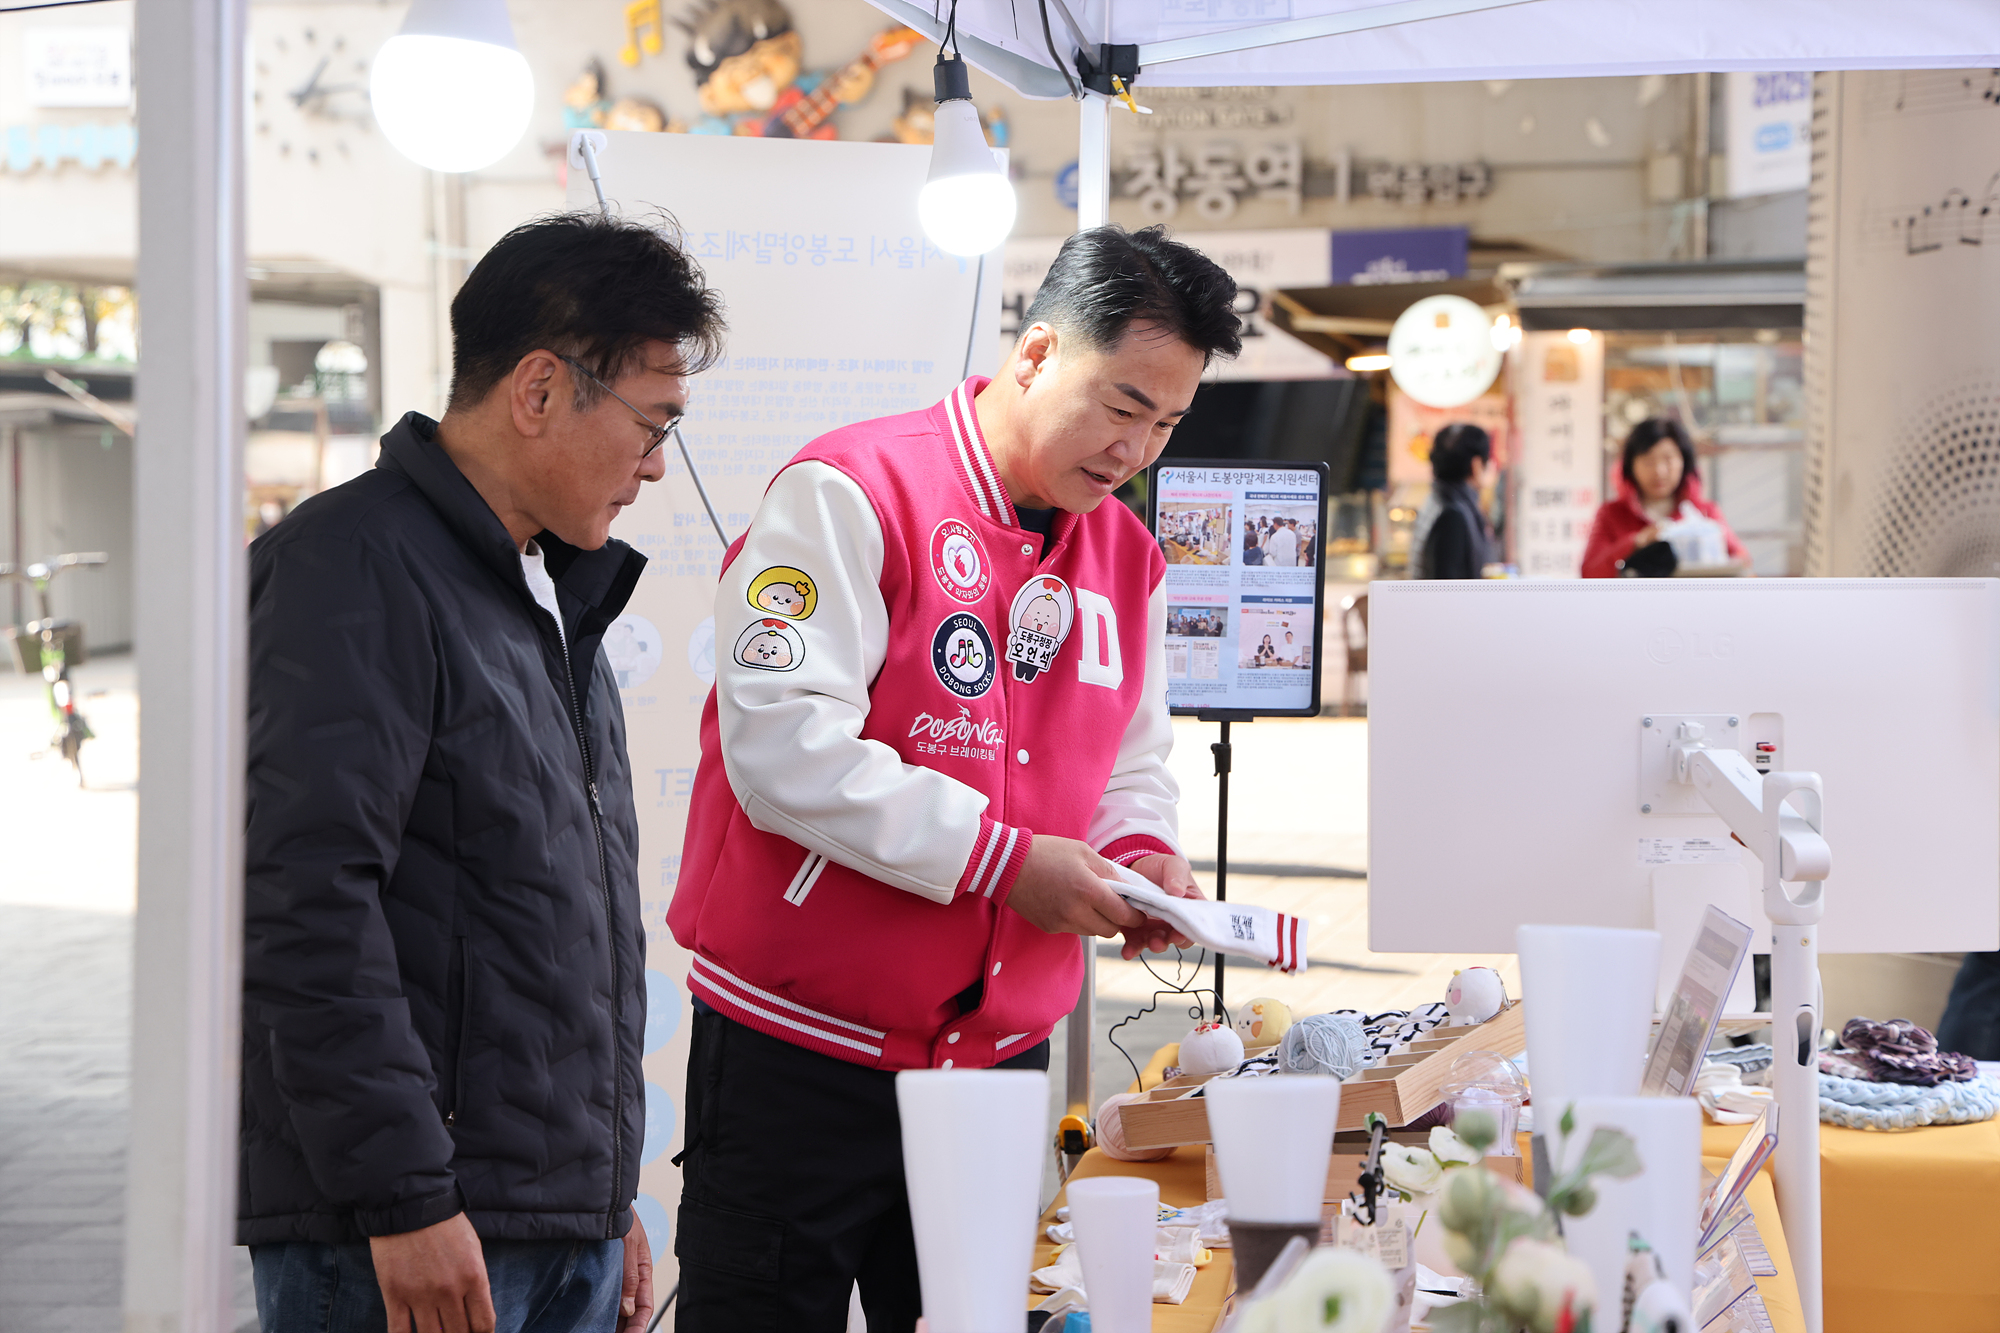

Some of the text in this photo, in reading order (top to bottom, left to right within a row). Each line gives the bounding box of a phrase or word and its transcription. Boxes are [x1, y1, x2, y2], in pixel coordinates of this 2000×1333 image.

[1124, 139, 1303, 220] 창동역
[1175, 470, 1319, 486] 서울시 도봉양말제조지원센터
[953, 617, 978, 631] SEOUL
[1019, 630, 1053, 649] 도봉구청장
[1075, 586, 1125, 691] D
[939, 665, 992, 694] DOBONG SOCKS
[908, 711, 999, 746] DOBONG
[916, 741, 996, 761] 도봉구 브레이킹팀
